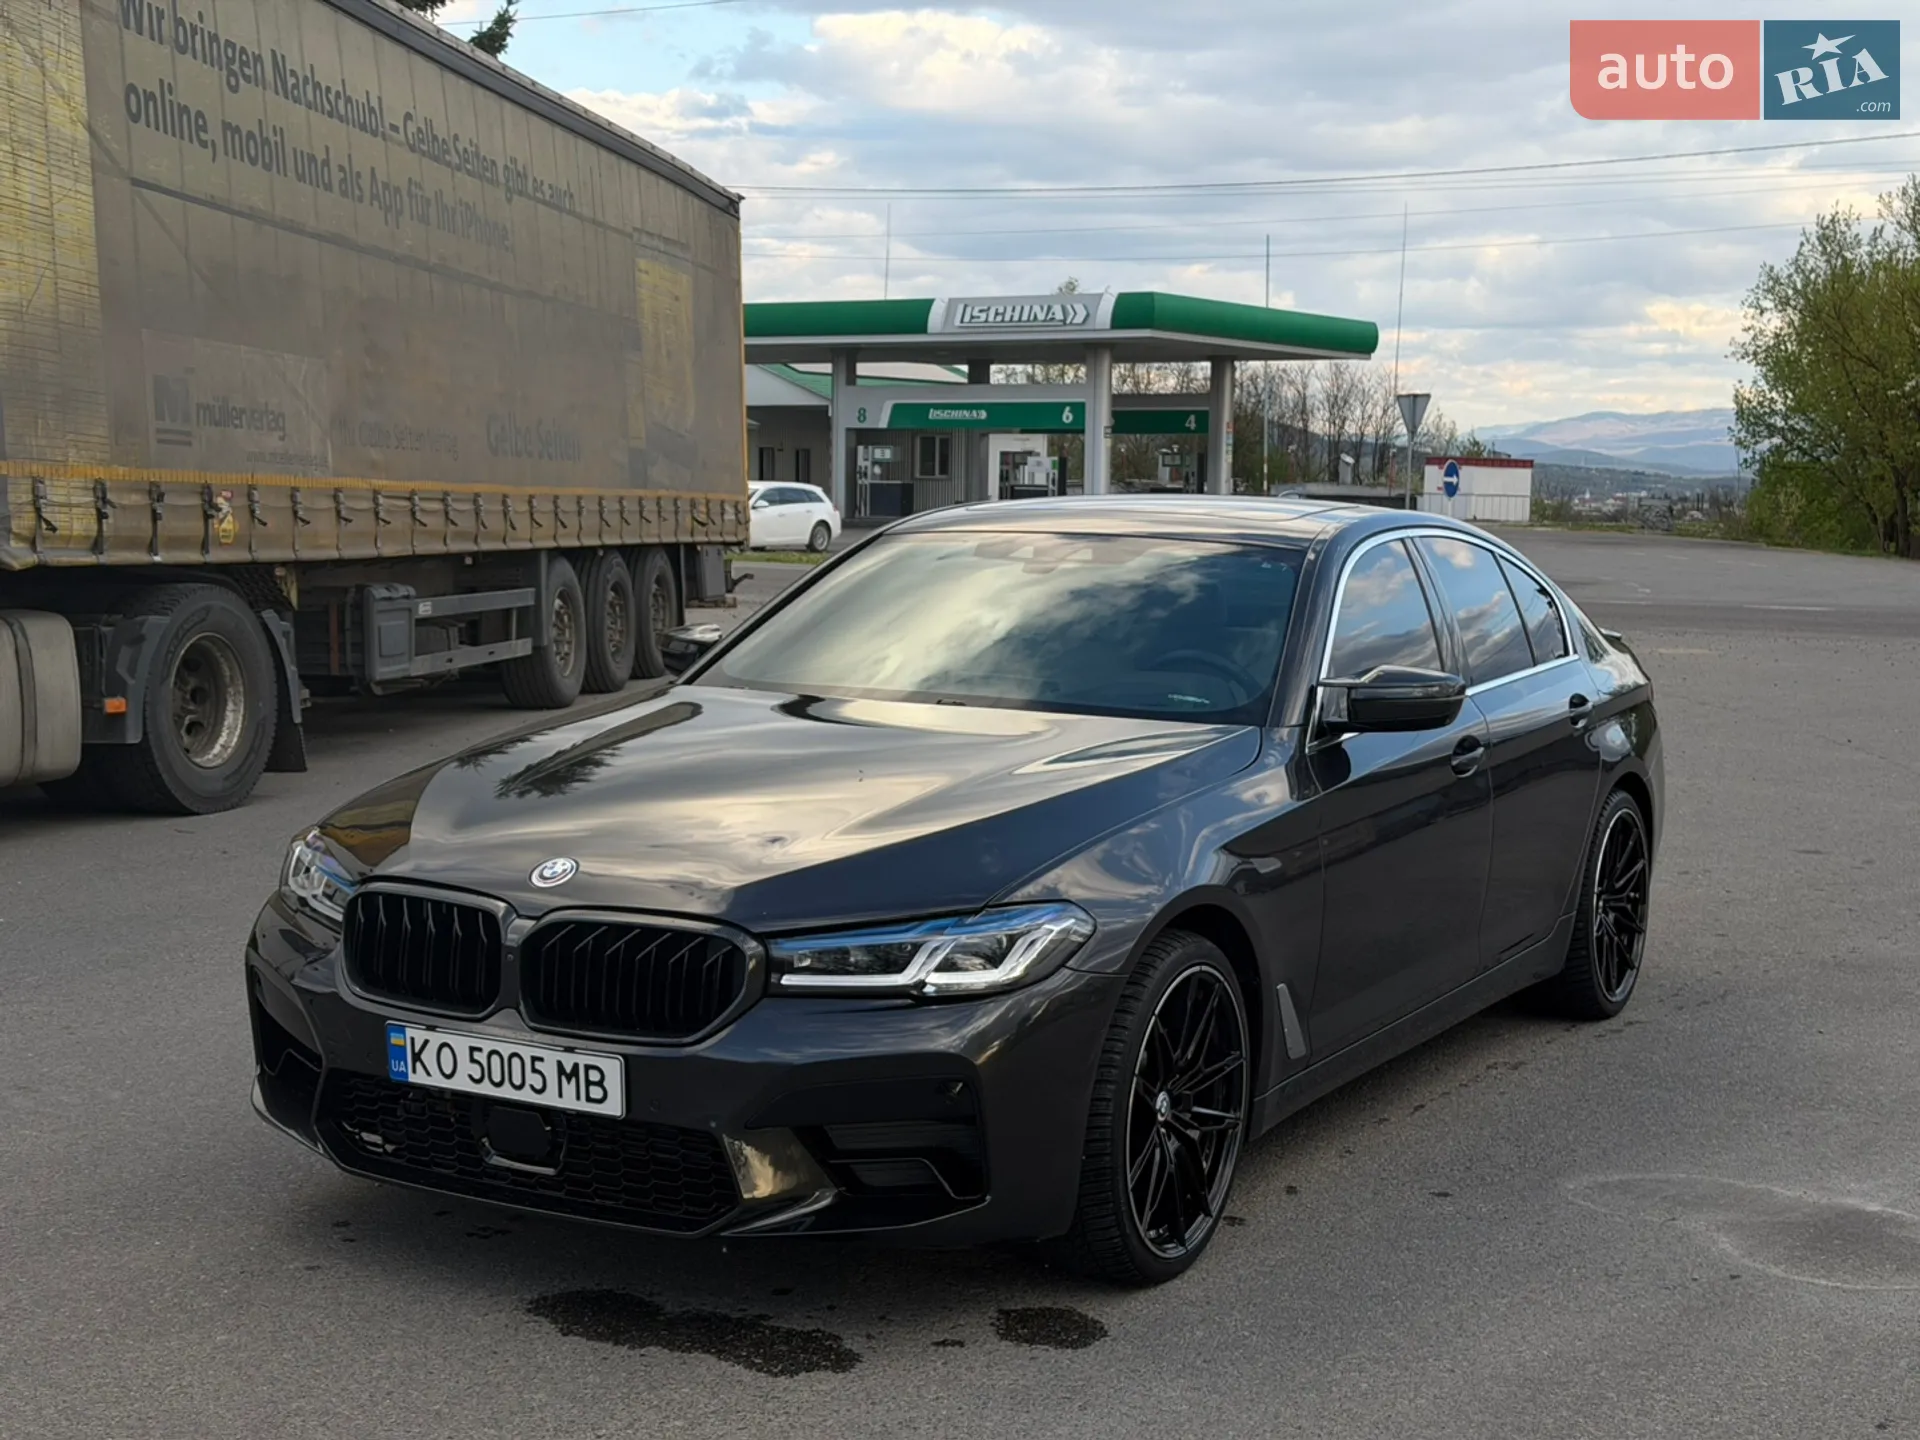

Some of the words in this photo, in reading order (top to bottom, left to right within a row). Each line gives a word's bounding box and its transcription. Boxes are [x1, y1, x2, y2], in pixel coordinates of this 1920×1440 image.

[120, 0, 165, 44] Wir
[172, 1, 266, 94] bringen
[269, 48, 386, 141] Nachschub!
[403, 111, 448, 166] Gelbe
[452, 132, 499, 188] Seiten
[503, 156, 528, 202] gibt
[532, 176, 545, 199] es
[548, 180, 575, 211] auch
[125, 79, 217, 163] online,
[221, 119, 287, 177] mobil
[294, 145, 332, 192] und
[338, 153, 364, 204] als
[370, 166, 403, 229] App
[407, 176, 431, 226] für
[435, 188, 457, 232] Ihr
[857, 407, 867, 423] 8
[1062, 406, 1073, 423] 6
[1185, 414, 1197, 430] 4
[391, 1059, 406, 1073] UA
[409, 1036, 458, 1080] KO
[467, 1046, 547, 1095] 5005
[557, 1060, 609, 1105] MB
